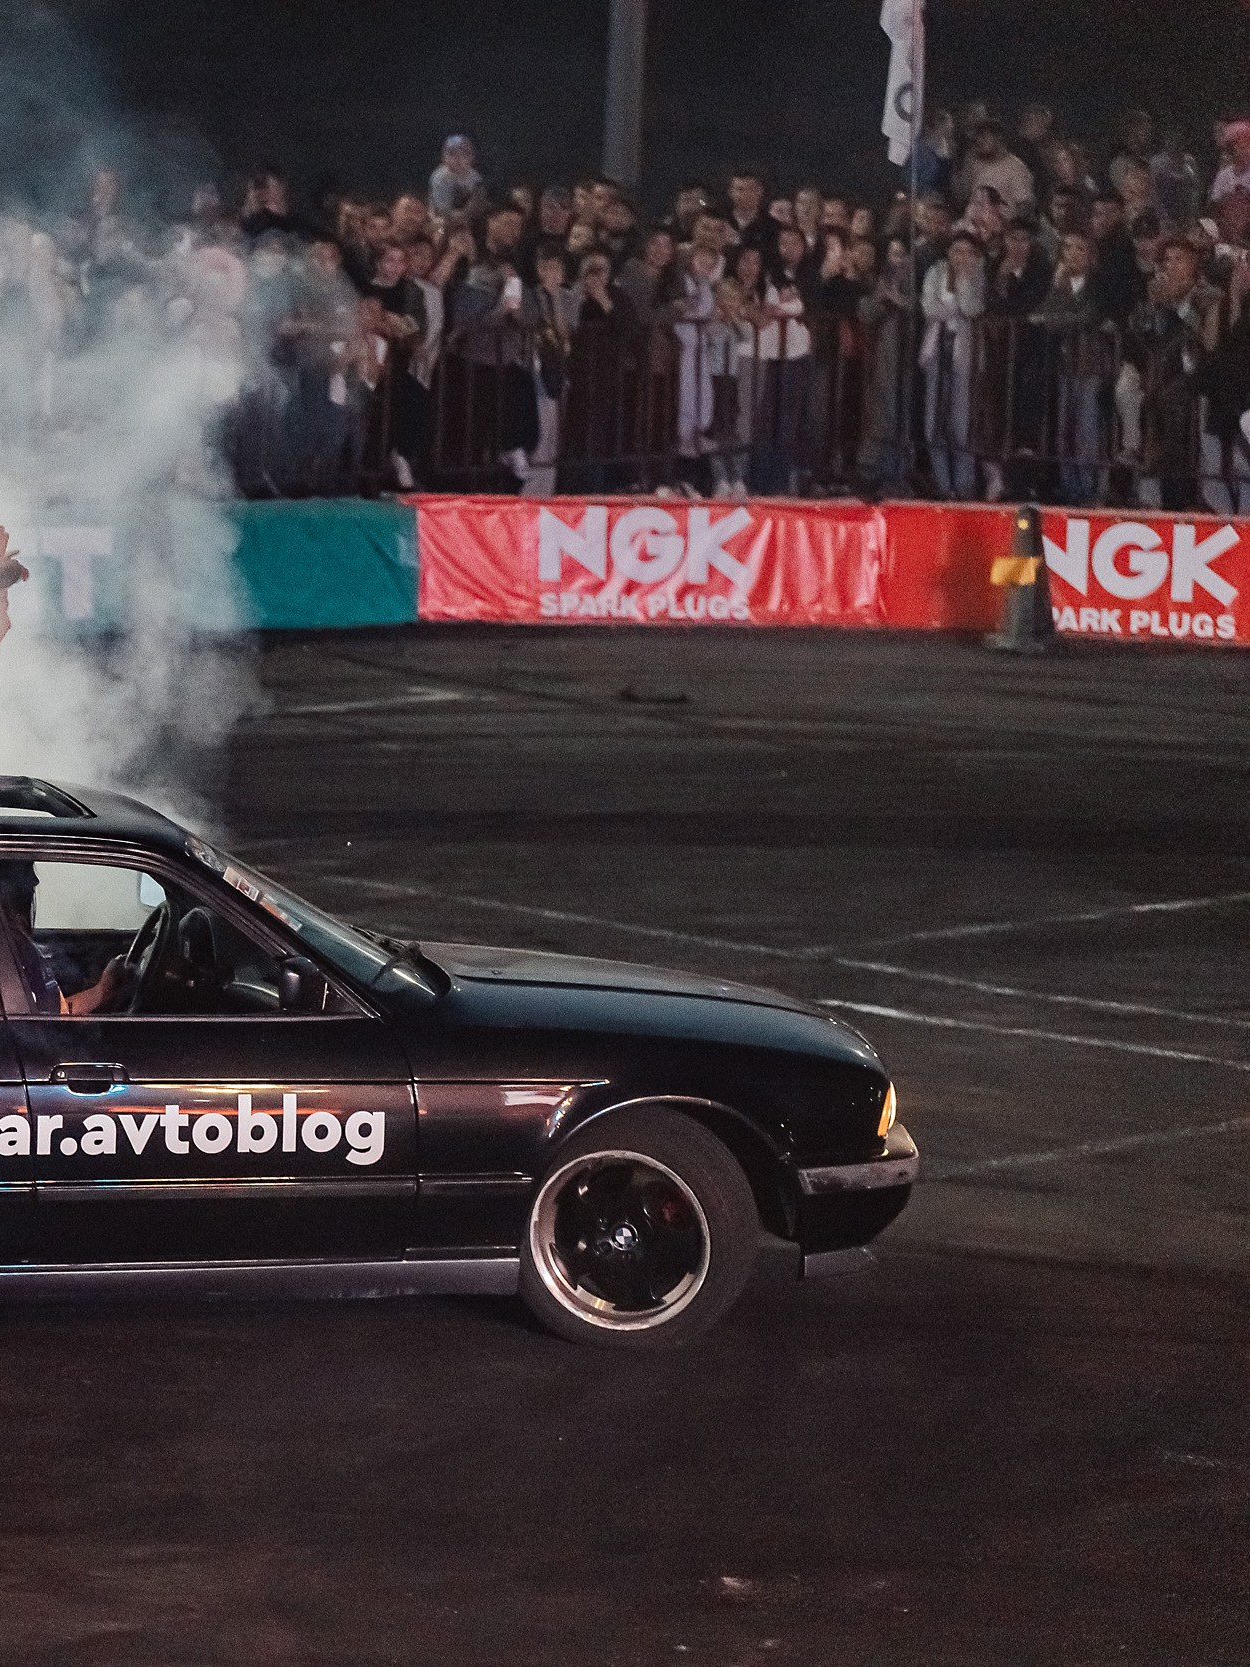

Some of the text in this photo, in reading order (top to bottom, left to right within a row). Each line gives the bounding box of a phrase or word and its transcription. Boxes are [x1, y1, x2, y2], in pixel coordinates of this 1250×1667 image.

[538, 505, 752, 584] NGK
[1041, 518, 1240, 607] NGK
[540, 592, 750, 620] SPARK PLUGS
[1052, 606, 1236, 639] ARK PLUGS
